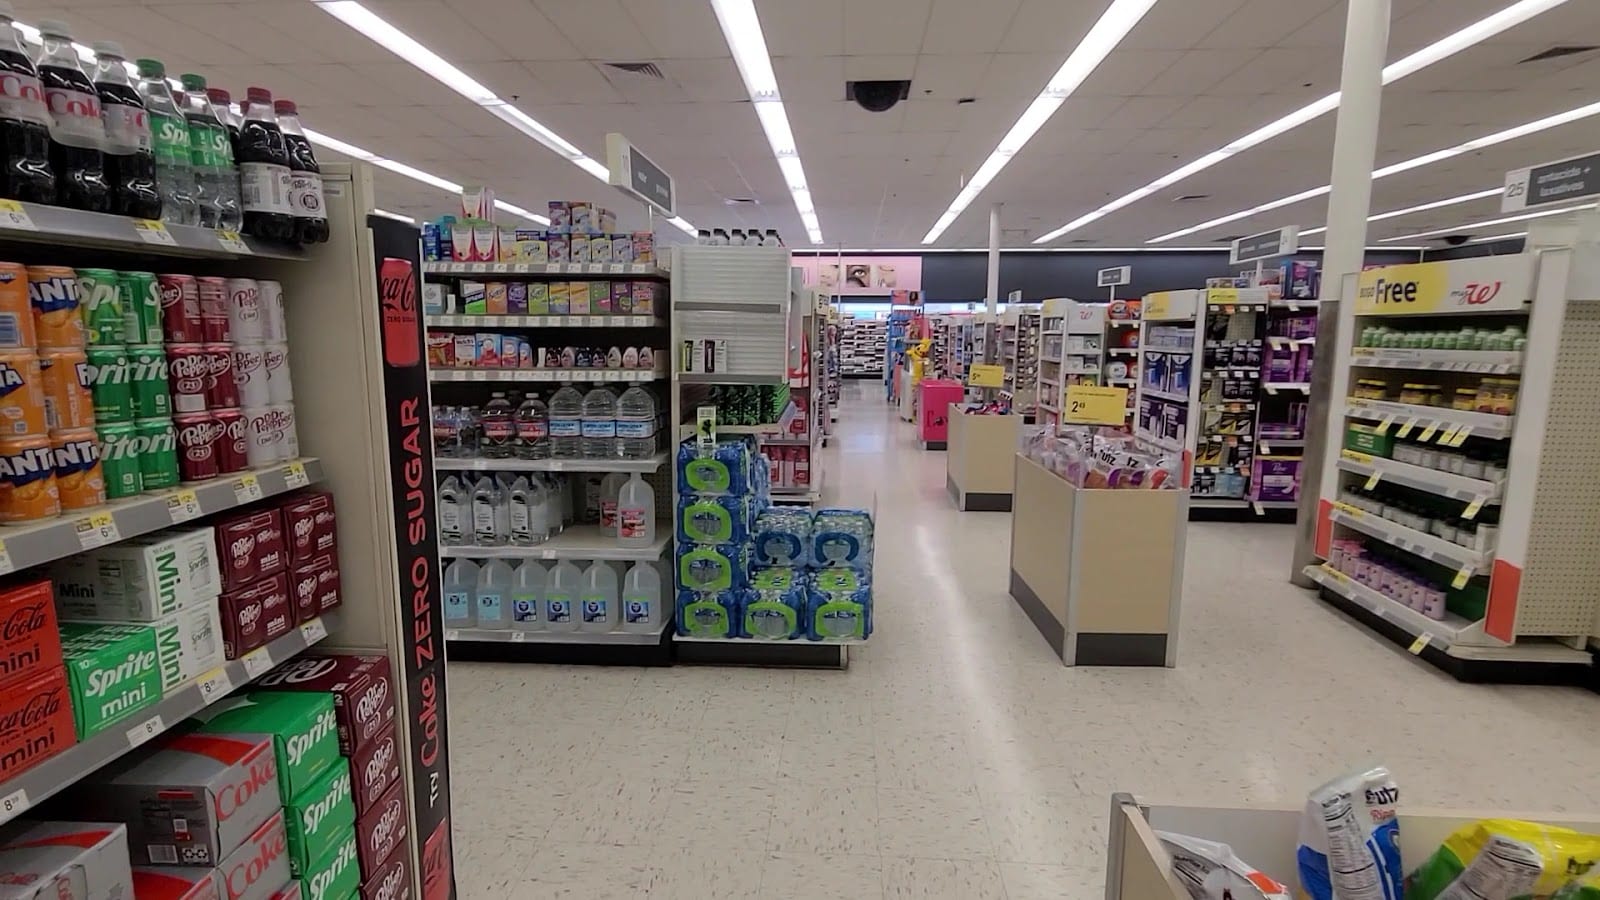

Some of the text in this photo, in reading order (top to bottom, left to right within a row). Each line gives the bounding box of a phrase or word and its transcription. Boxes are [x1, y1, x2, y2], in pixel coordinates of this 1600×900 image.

[1507, 182, 1524, 198] 25
[1375, 279, 1417, 304] Free
[401, 397, 426, 546] SUGAR
[59, 583, 95, 598] Mini
[156, 551, 182, 614] Mini
[411, 556, 435, 670] ZERO
[84, 650, 156, 697] Sprite
[158, 625, 187, 688] Mini
[101, 682, 147, 719] mini
[419, 673, 438, 767] Coke
[1, 726, 55, 770] mini
